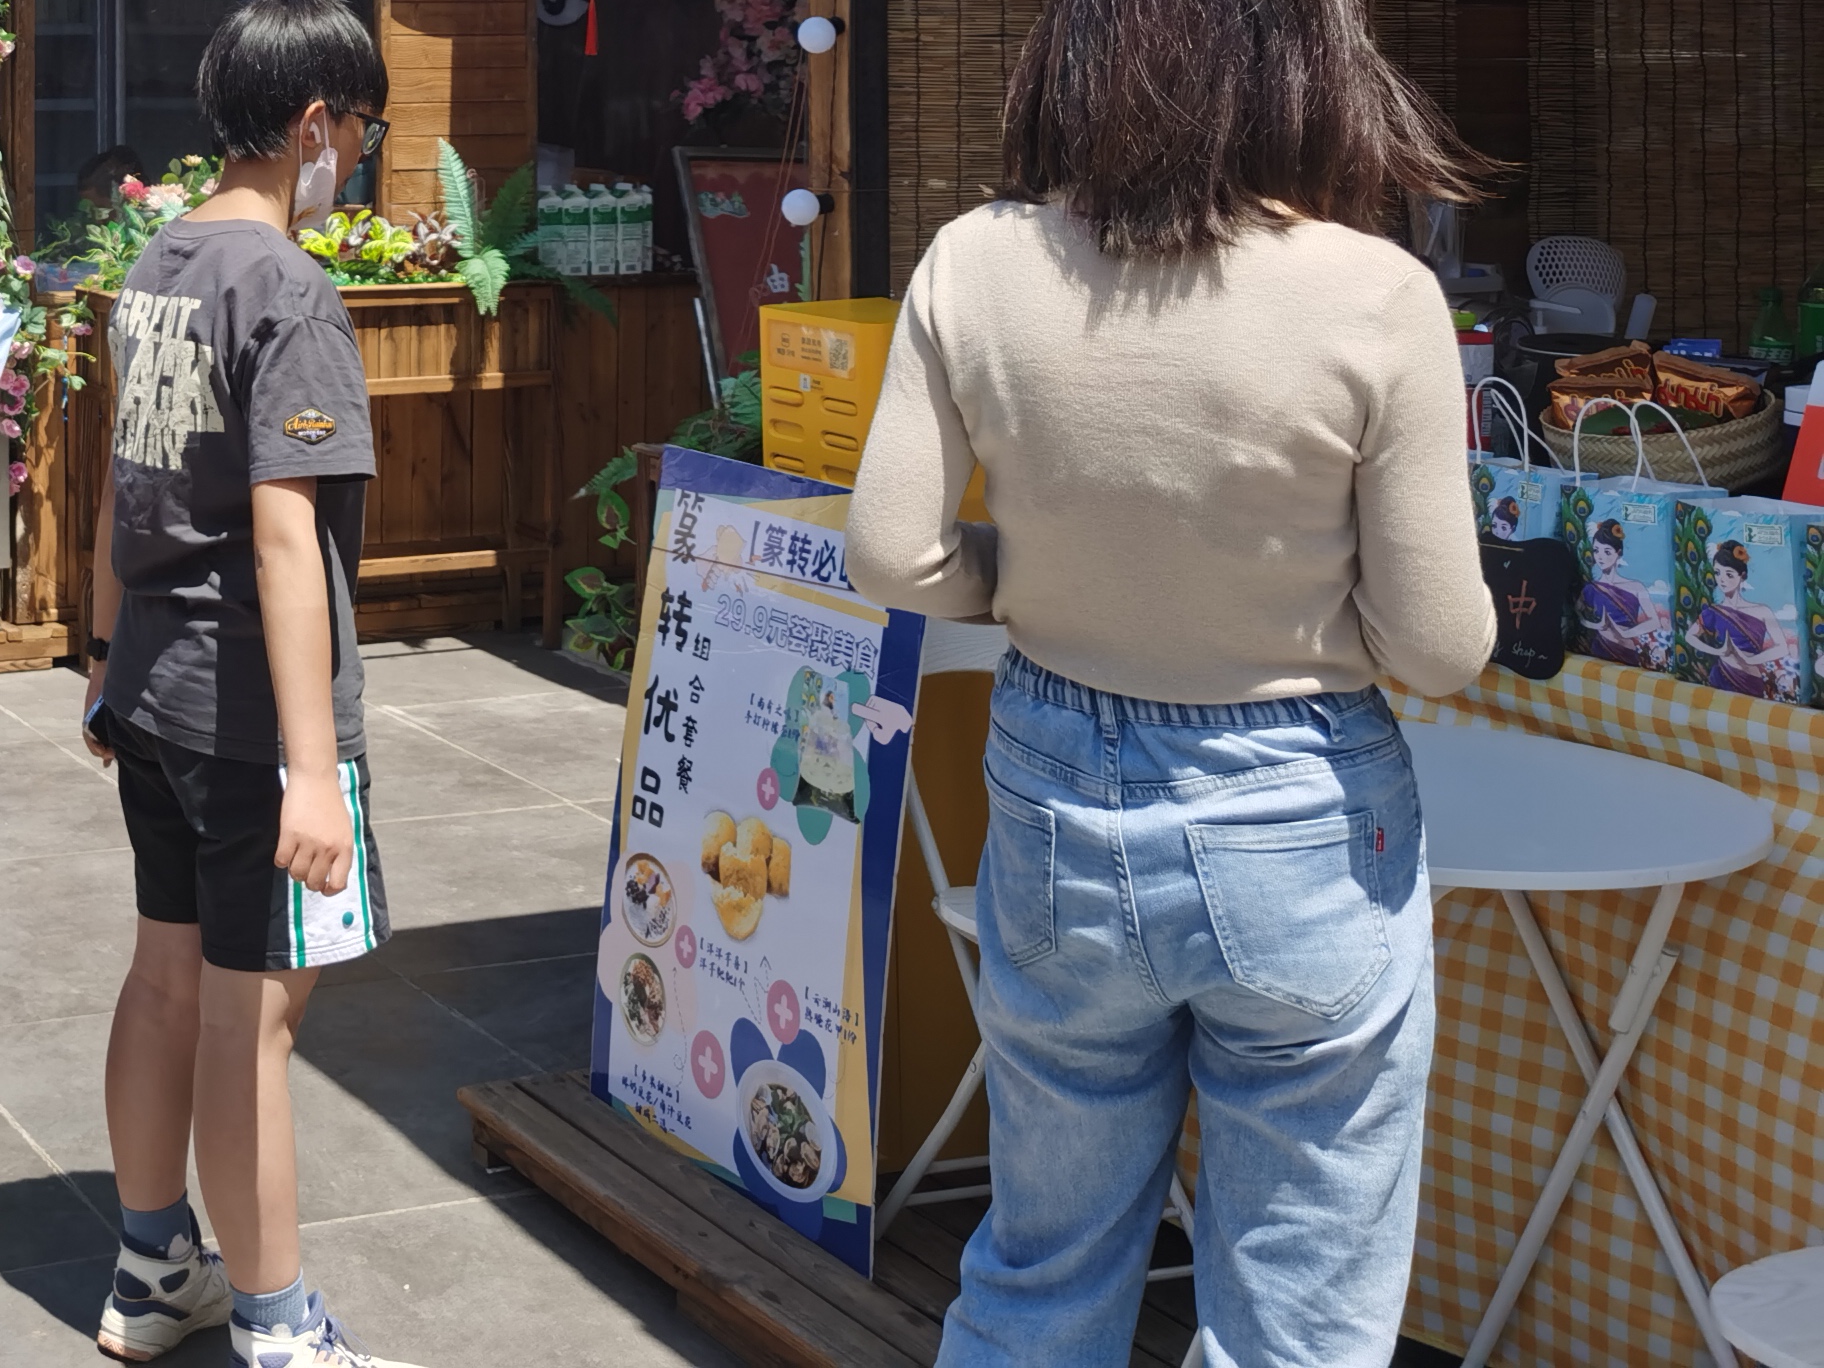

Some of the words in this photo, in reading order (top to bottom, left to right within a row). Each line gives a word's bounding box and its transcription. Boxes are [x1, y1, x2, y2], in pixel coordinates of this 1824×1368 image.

[632, 489, 705, 829] 篆转优品
[715, 594, 878, 680] 29.9元荟聚美食
[1507, 579, 1537, 630] 中
[677, 633, 711, 794] 组合套餐
